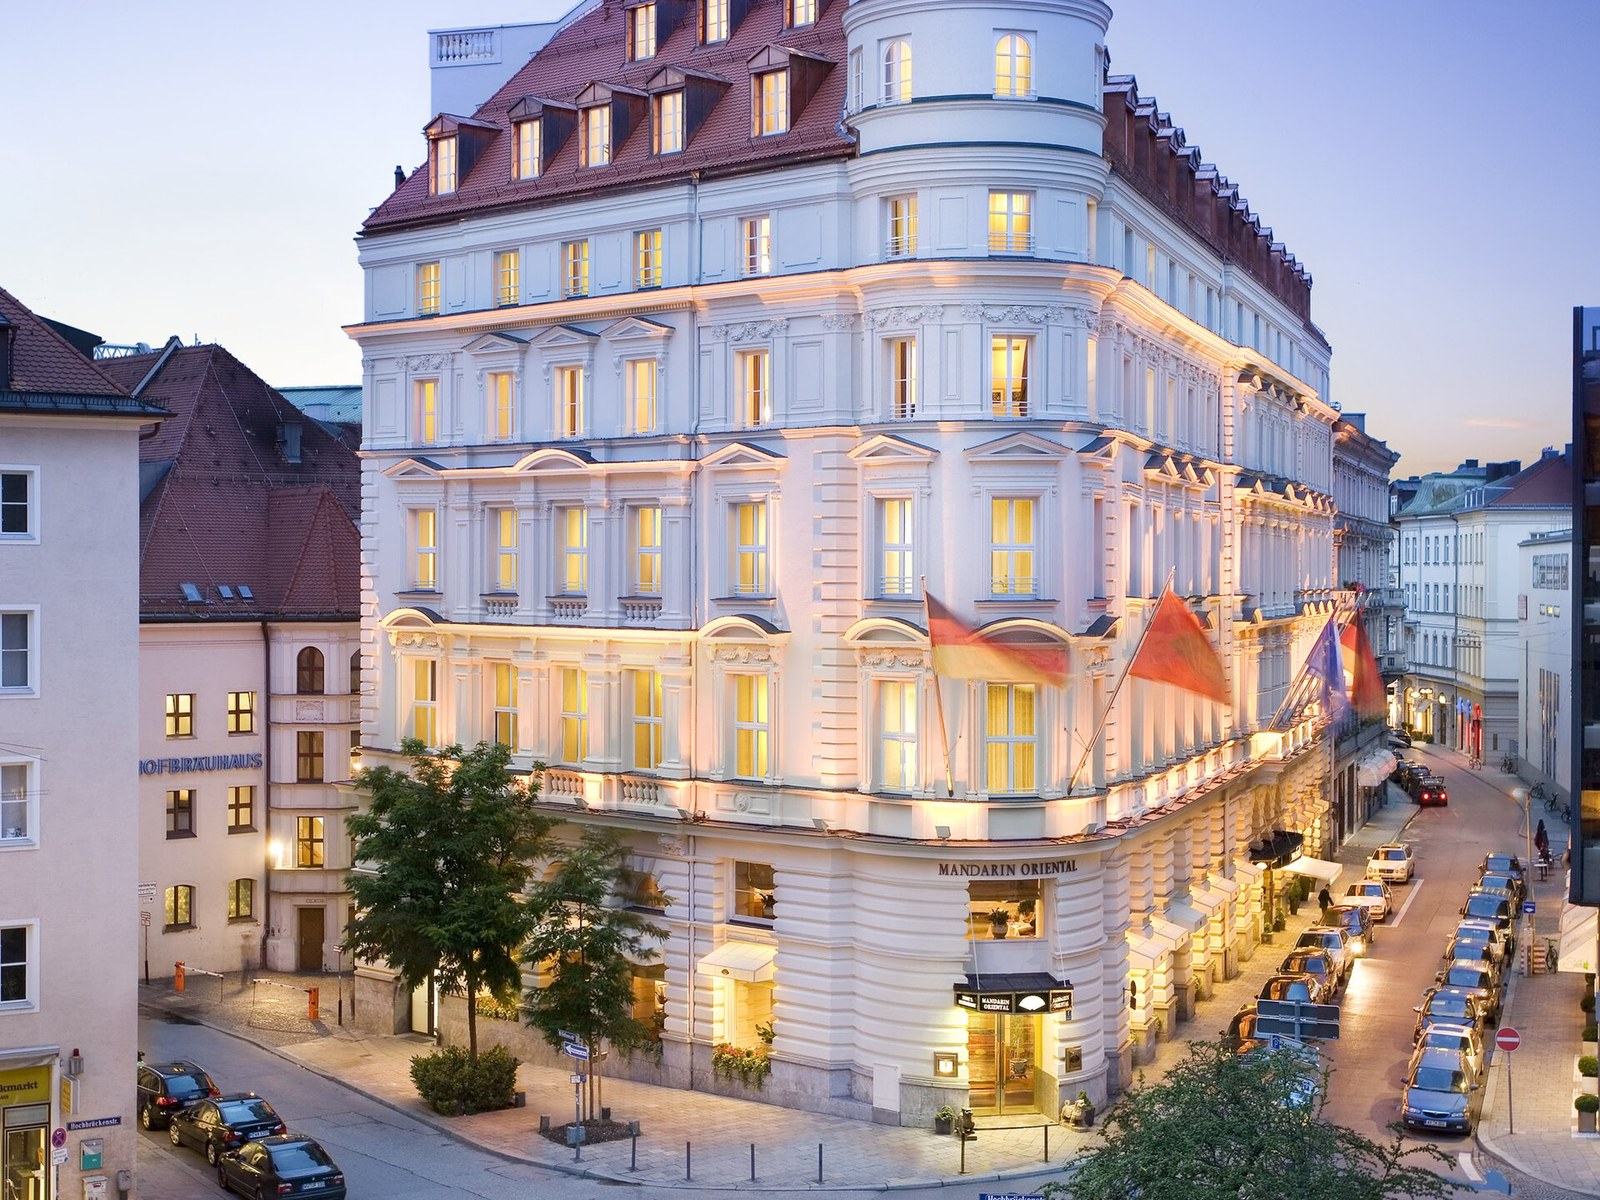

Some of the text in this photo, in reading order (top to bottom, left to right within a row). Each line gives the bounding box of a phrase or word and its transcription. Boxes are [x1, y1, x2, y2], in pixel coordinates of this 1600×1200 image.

[139, 753, 263, 775] OFBRÄUHAUS
[938, 860, 1077, 877] MANDARIN ORIENTAL
[70, 1119, 119, 1129] Hochbrückenstr.
